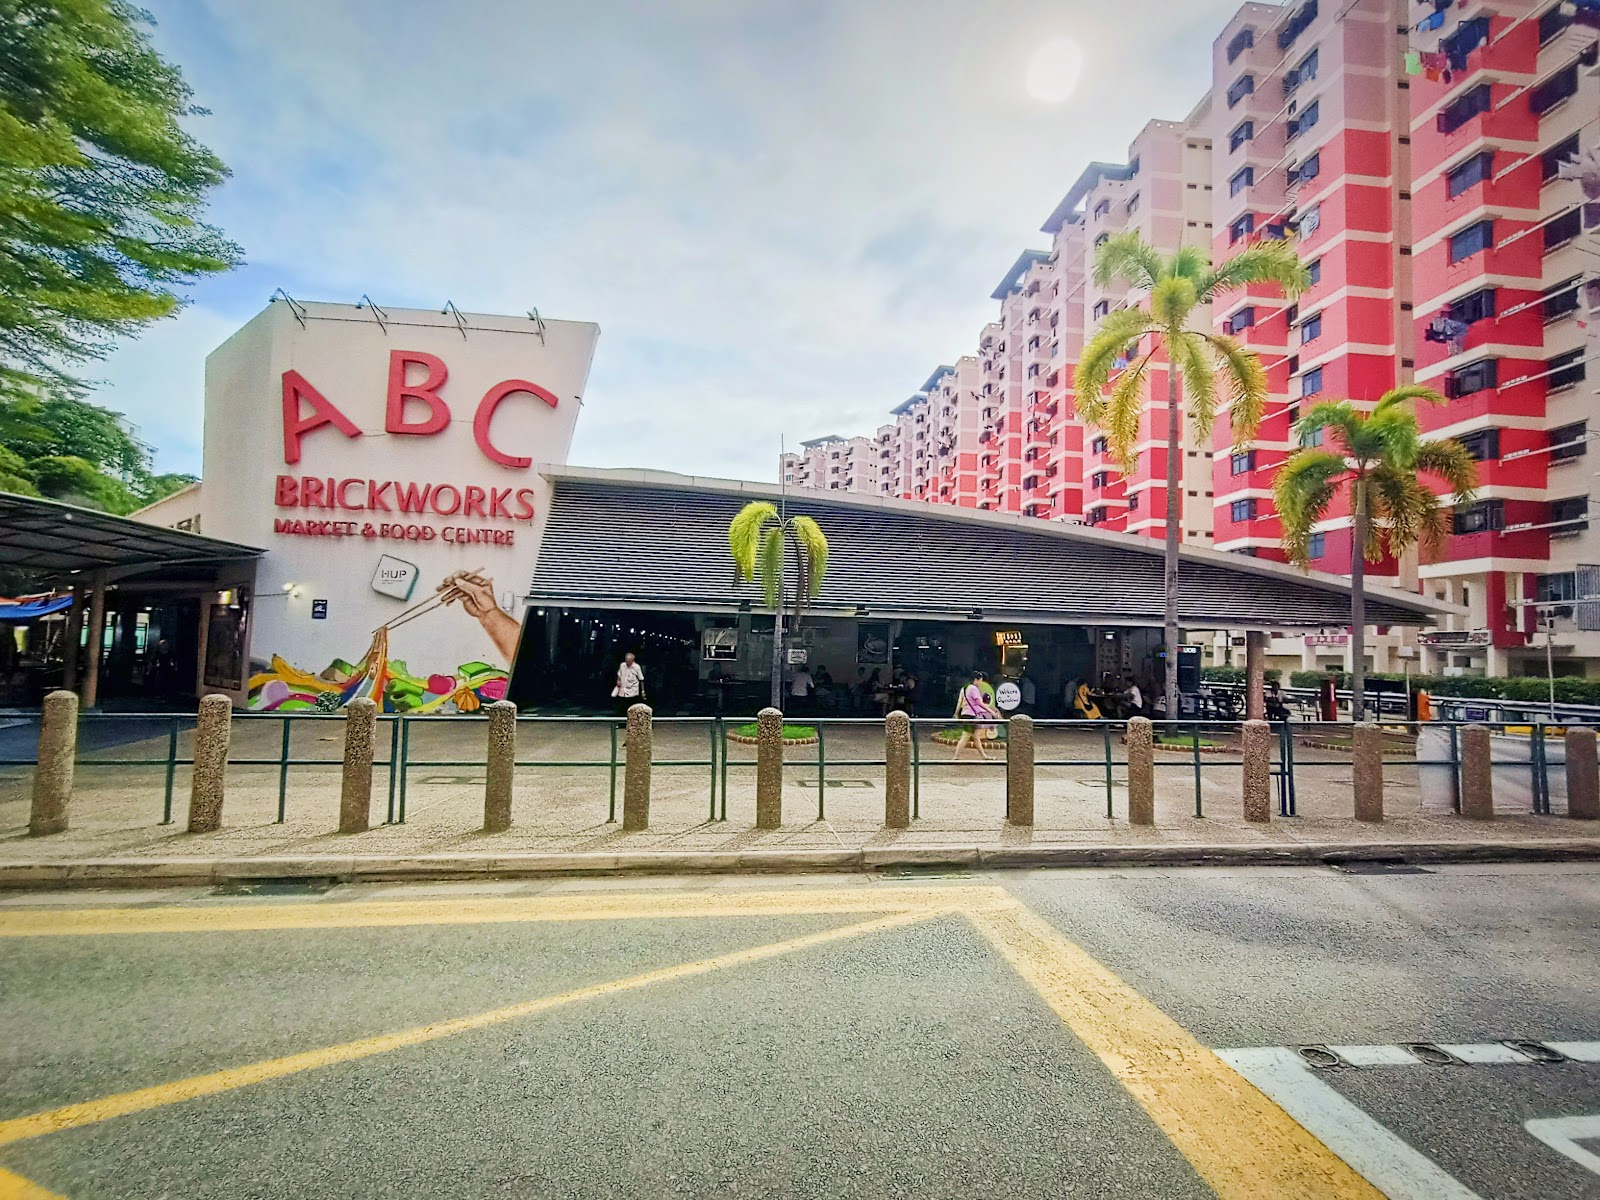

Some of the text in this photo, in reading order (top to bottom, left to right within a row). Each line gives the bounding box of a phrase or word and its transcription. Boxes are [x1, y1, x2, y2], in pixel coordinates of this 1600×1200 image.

[281, 349, 559, 469] ABC
[274, 474, 535, 520] BRICKWORKS
[273, 518, 515, 546] MARKET & FOOD CENTRE
[381, 569, 408, 579] HUP
